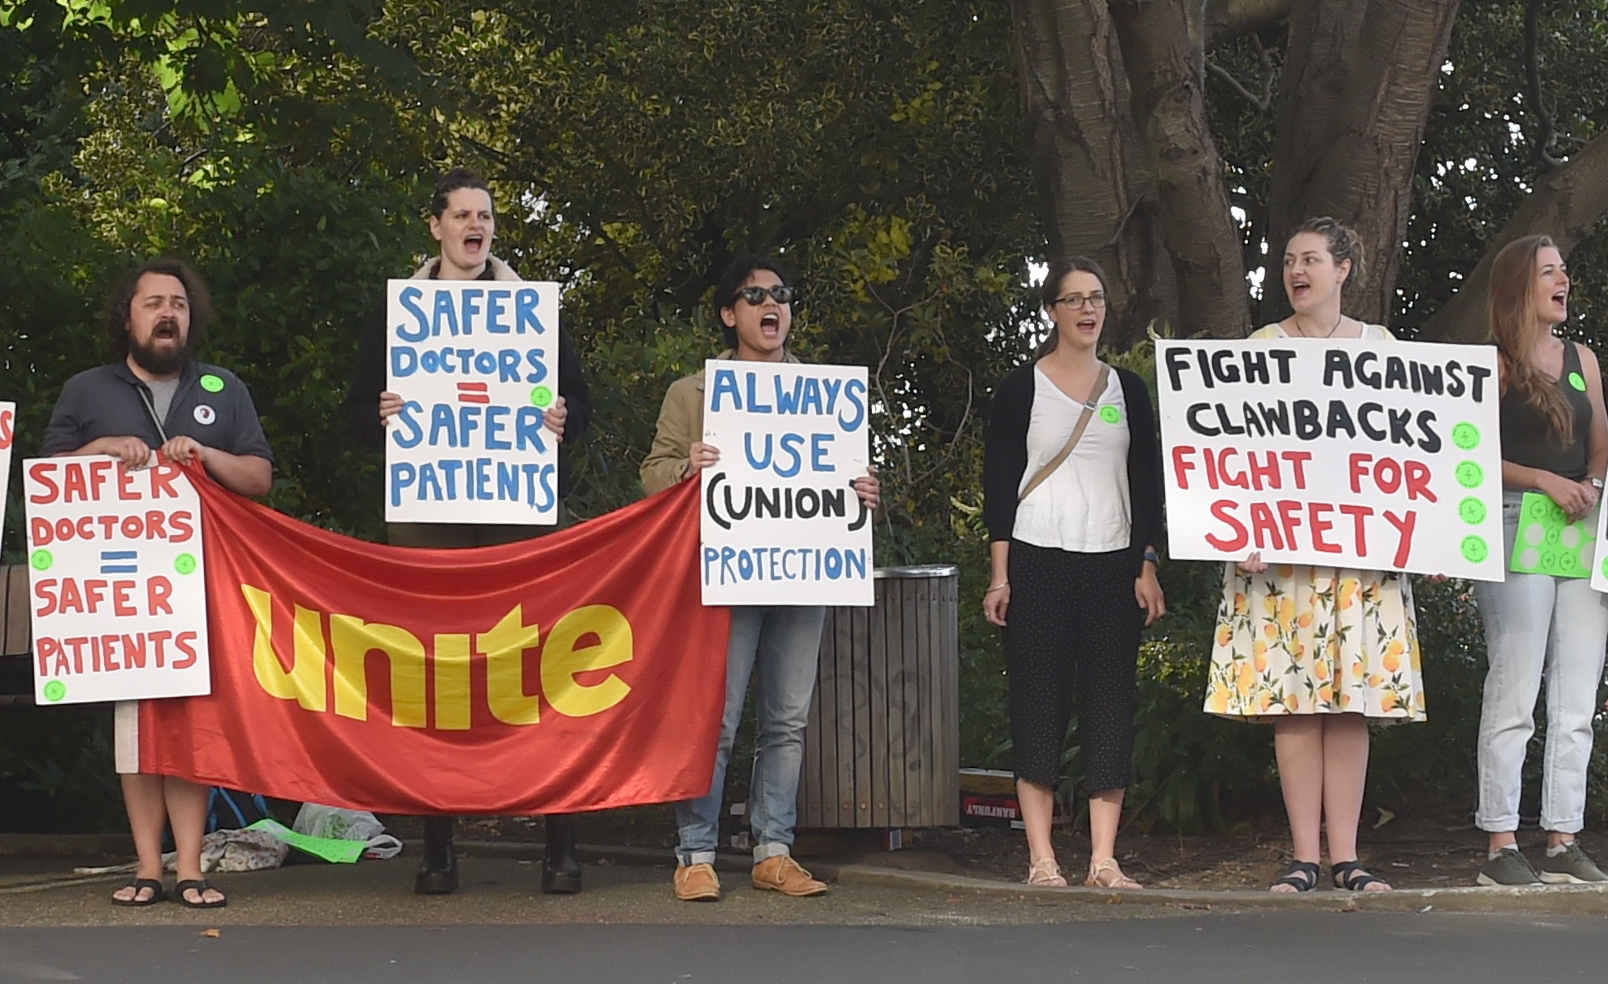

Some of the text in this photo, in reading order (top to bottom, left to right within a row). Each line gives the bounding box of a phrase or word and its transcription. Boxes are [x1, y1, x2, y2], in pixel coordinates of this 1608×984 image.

[396, 286, 545, 342] SAFER
[391, 346, 548, 383] DOCTORS
[1165, 347, 1491, 402] FIGHT AGAINST
[711, 369, 866, 432] ALWAYS
[1186, 400, 1442, 453] CLAWBACKS
[392, 401, 548, 454] SAFER
[744, 432, 836, 478] USE
[1171, 446, 1312, 491] FIGHT
[1349, 453, 1439, 503] FOR
[29, 460, 183, 504] SAFER
[391, 458, 555, 513] PATIENTS
[706, 472, 868, 531] (UNION)
[31, 511, 193, 546] DOCTORS
[1204, 499, 1417, 568] SAFETY
[704, 546, 866, 585] PROTECTION
[35, 576, 173, 617] SAFER
[37, 630, 197, 676] PATIENTS
[241, 583, 634, 730] unite
[967, 804, 1016, 818] RANFURLY
